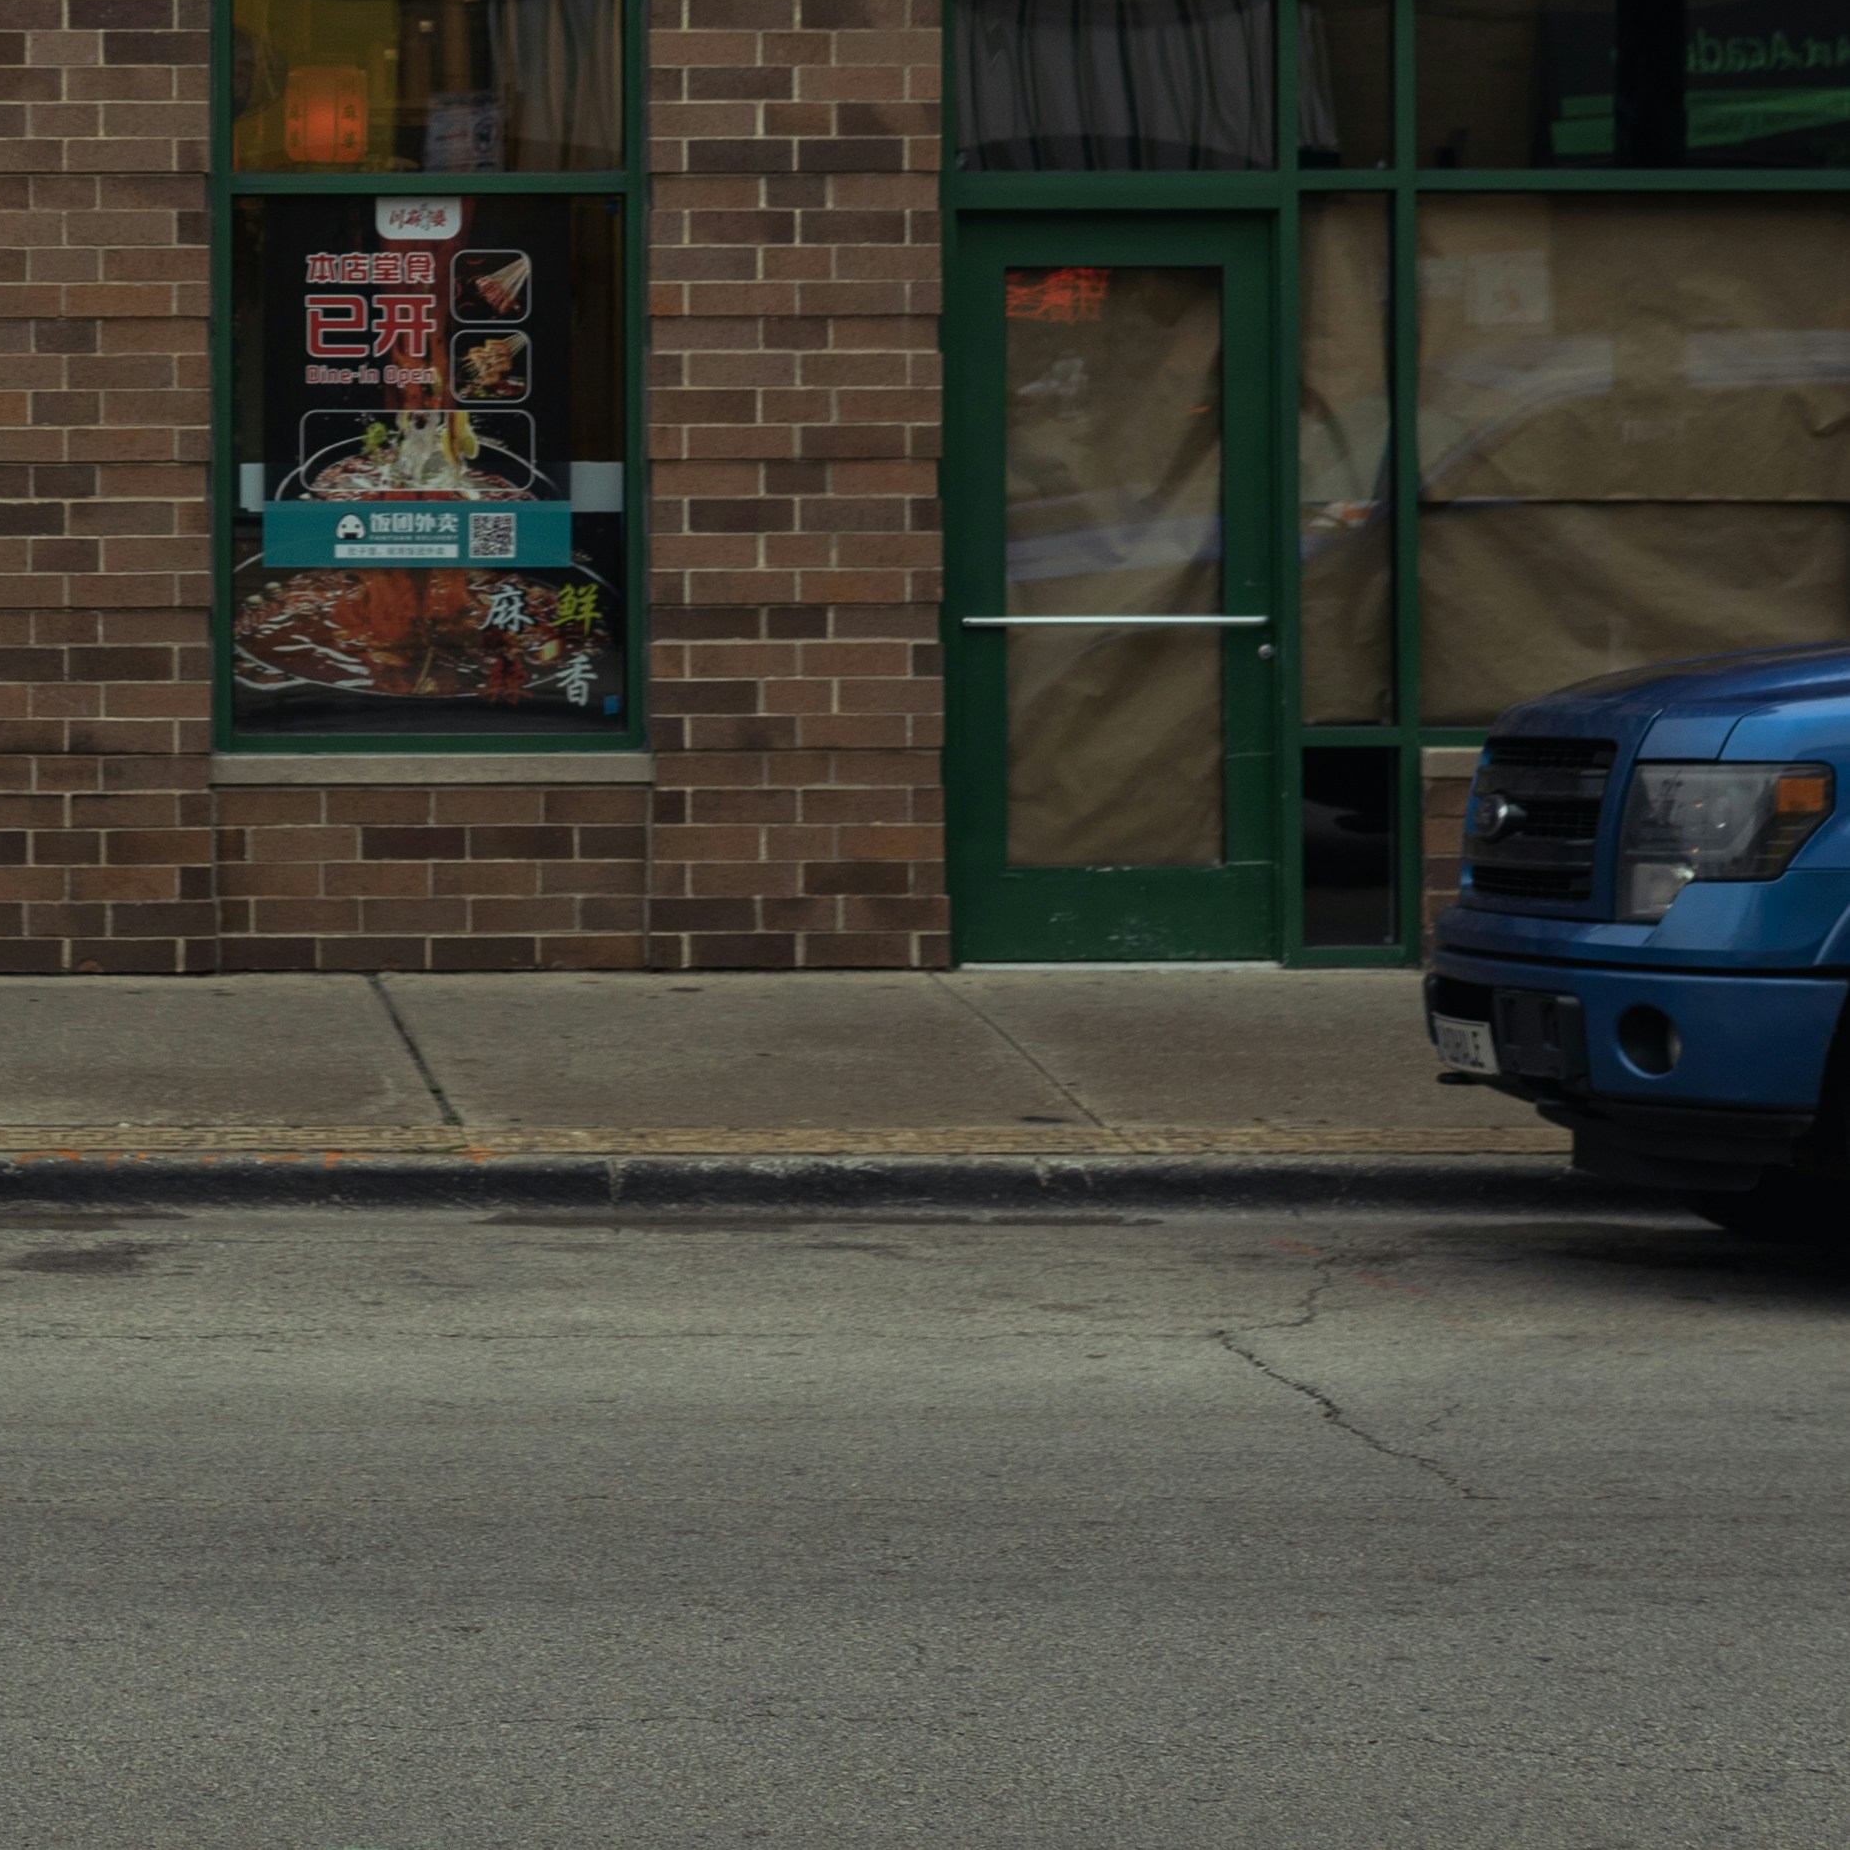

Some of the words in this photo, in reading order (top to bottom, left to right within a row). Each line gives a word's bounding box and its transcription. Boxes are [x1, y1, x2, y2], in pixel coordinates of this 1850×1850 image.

[305, 252, 436, 284] 本店堂食
[304, 294, 437, 358] 已开
[305, 364, 381, 384] Dine-In
[383, 364, 437, 388] Open
[368, 512, 459, 533] 饭团外卖
